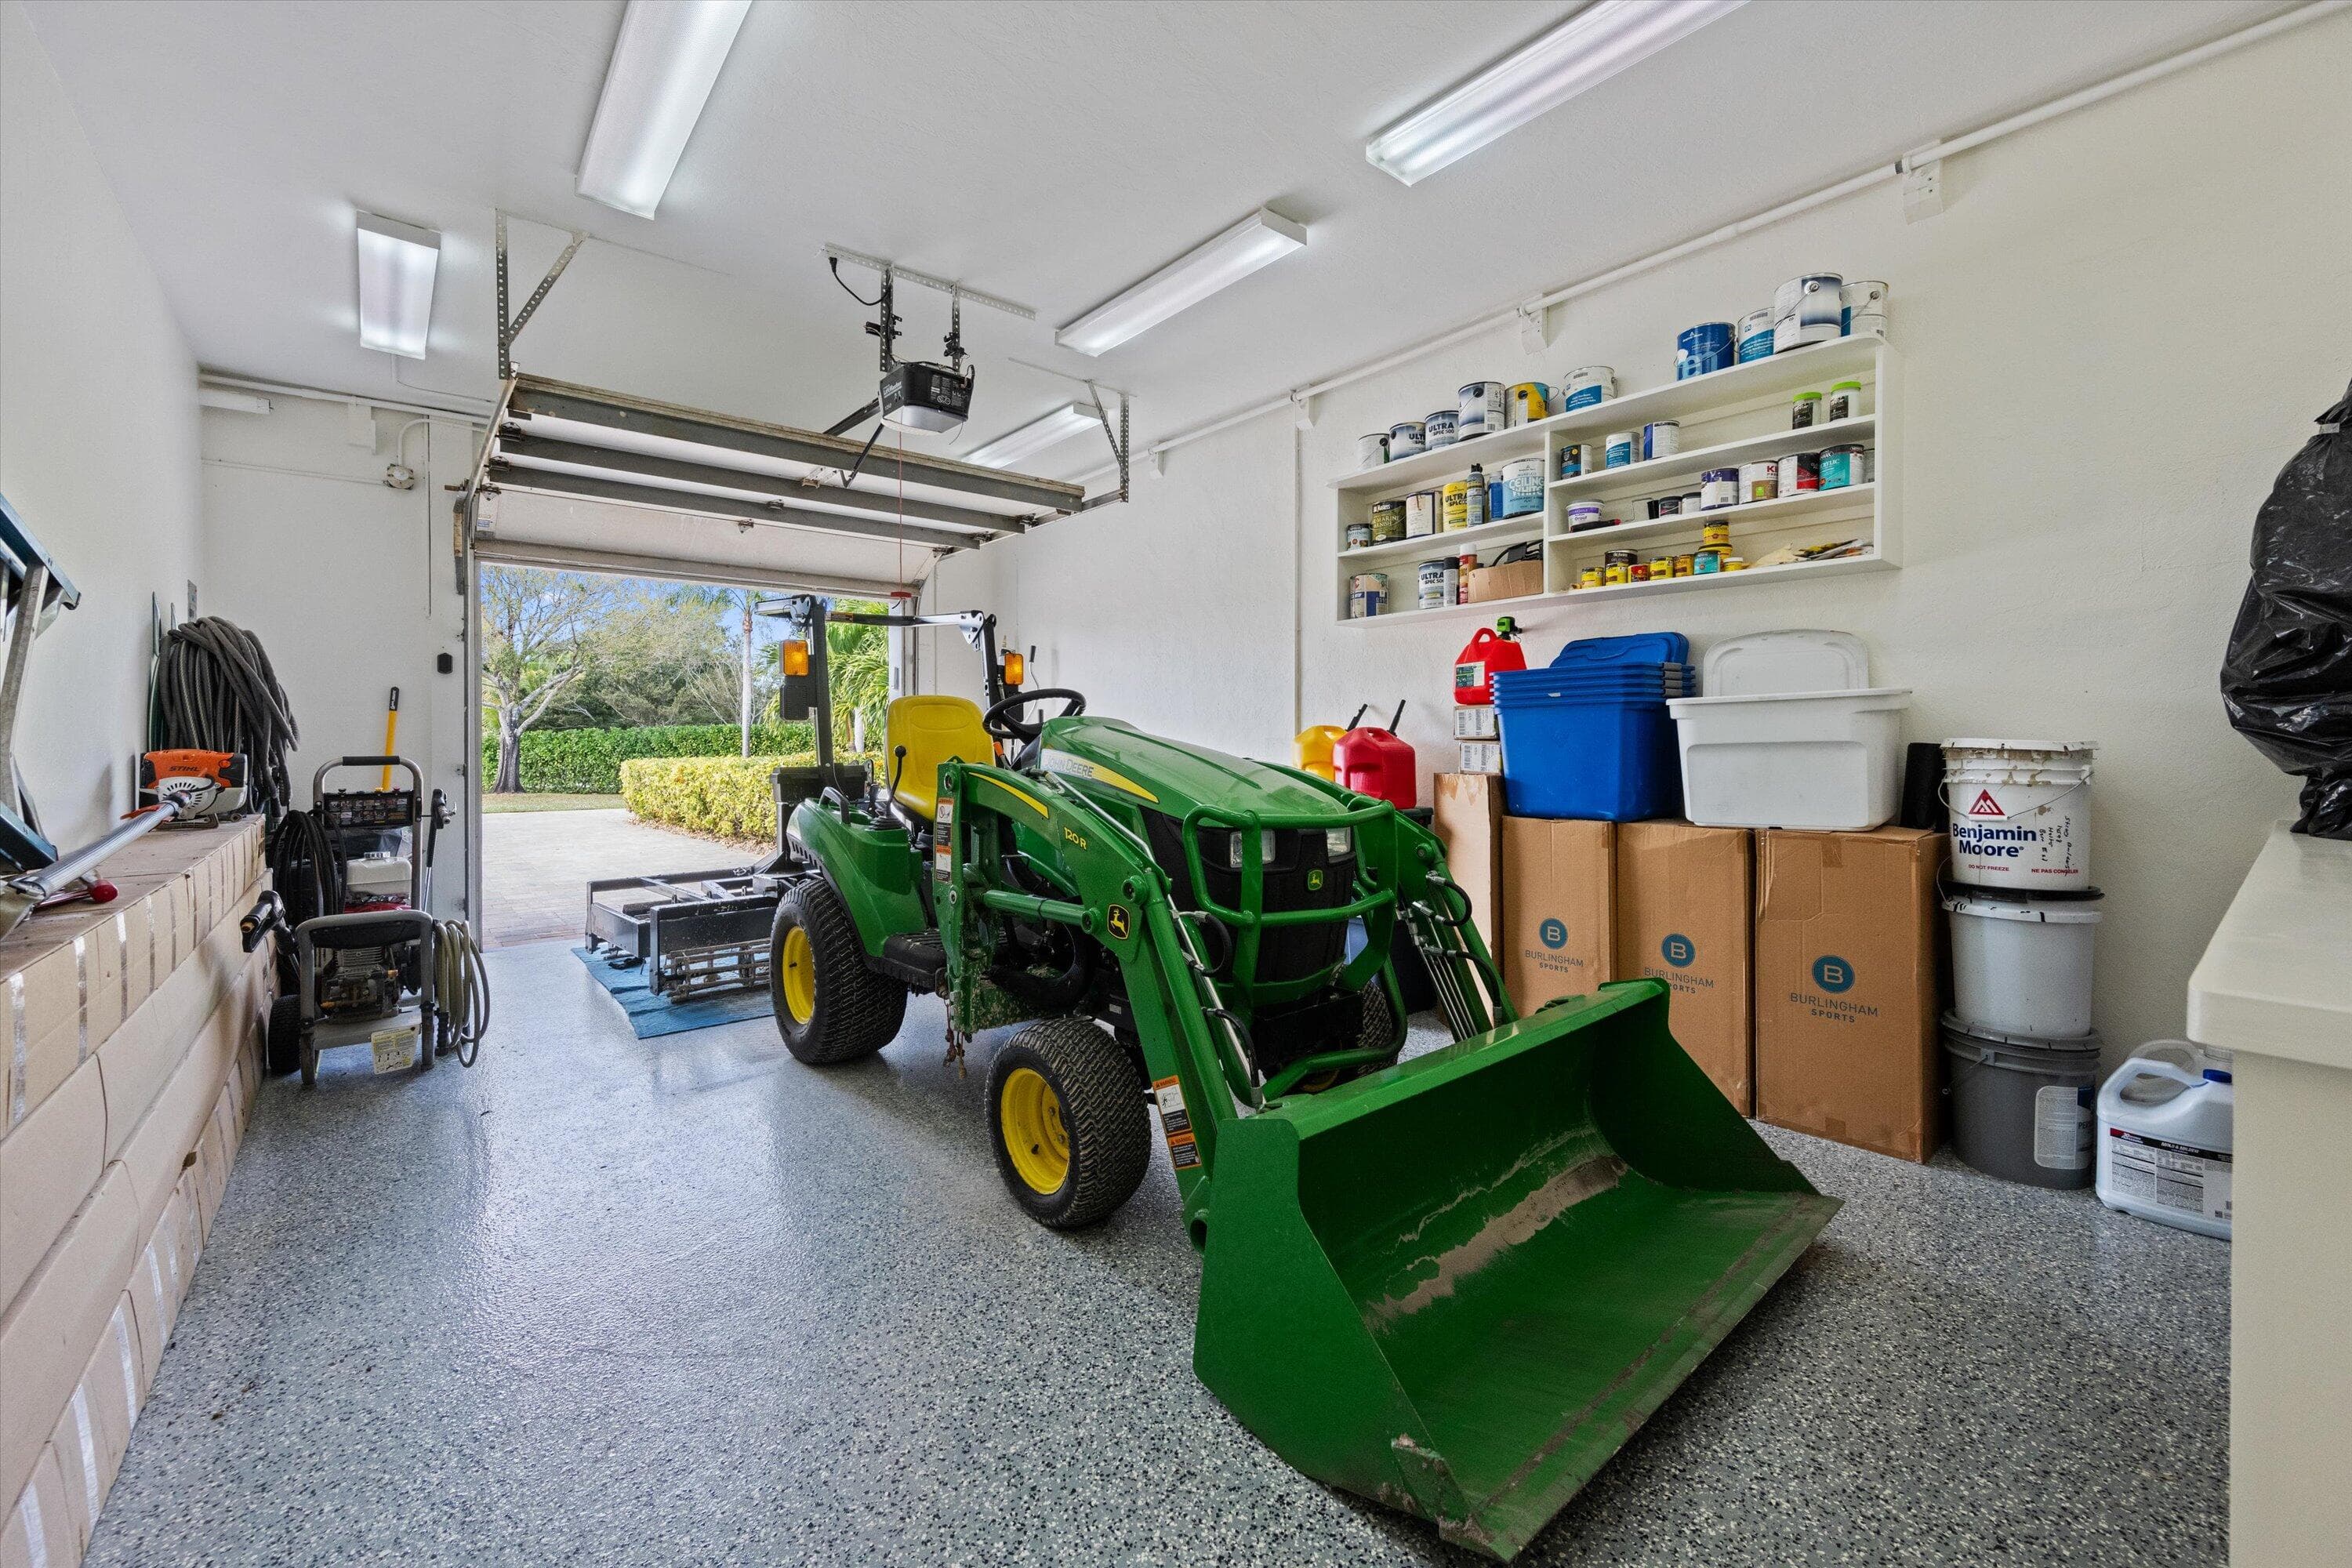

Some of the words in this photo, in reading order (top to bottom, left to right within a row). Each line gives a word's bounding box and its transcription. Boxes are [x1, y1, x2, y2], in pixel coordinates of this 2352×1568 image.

[1428, 422, 1455, 433] ULTRA
[1509, 476, 1544, 488] CEILING
[1445, 492, 1467, 503] ULTRA
[1421, 572, 1444, 580] ULTRA
[1066, 759, 1094, 779] DEERE
[1953, 823, 2037, 843] Benjamin
[1547, 926, 1561, 942] B
[1525, 949, 1584, 967] BURLINGHAM
[1670, 942, 1686, 960] B
[1539, 962, 1568, 973] SPORTS
[1824, 964, 1844, 984] B
[1644, 967, 1715, 989] BURLINGHAM
[1669, 982, 1697, 994] PORTS
[1790, 992, 1878, 1018] BURLINGHAM
[1811, 1008, 1856, 1023] SPORTS
